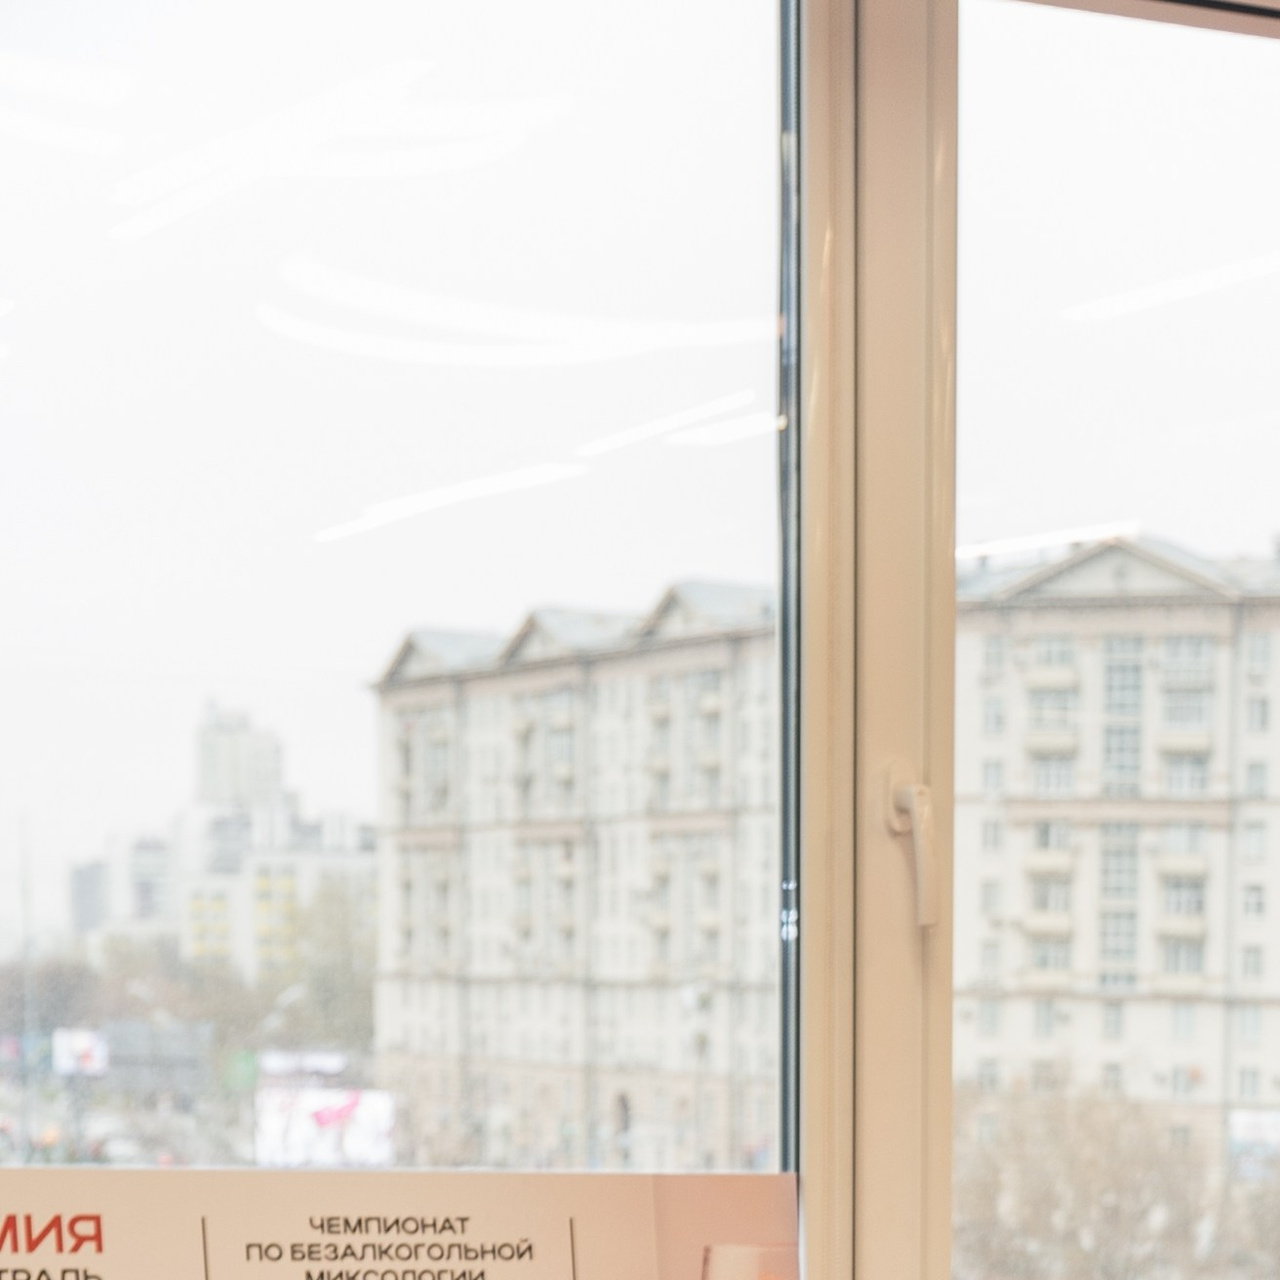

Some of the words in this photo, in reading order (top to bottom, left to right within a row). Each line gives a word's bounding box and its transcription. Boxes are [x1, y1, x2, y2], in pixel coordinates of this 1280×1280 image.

[309, 1217, 469, 1234] ЧЕМПИОНАТ
[246, 1244, 283, 1261] ПО
[291, 1239, 533, 1261] БЕЗАЛКОГОЛЬНОЙ
